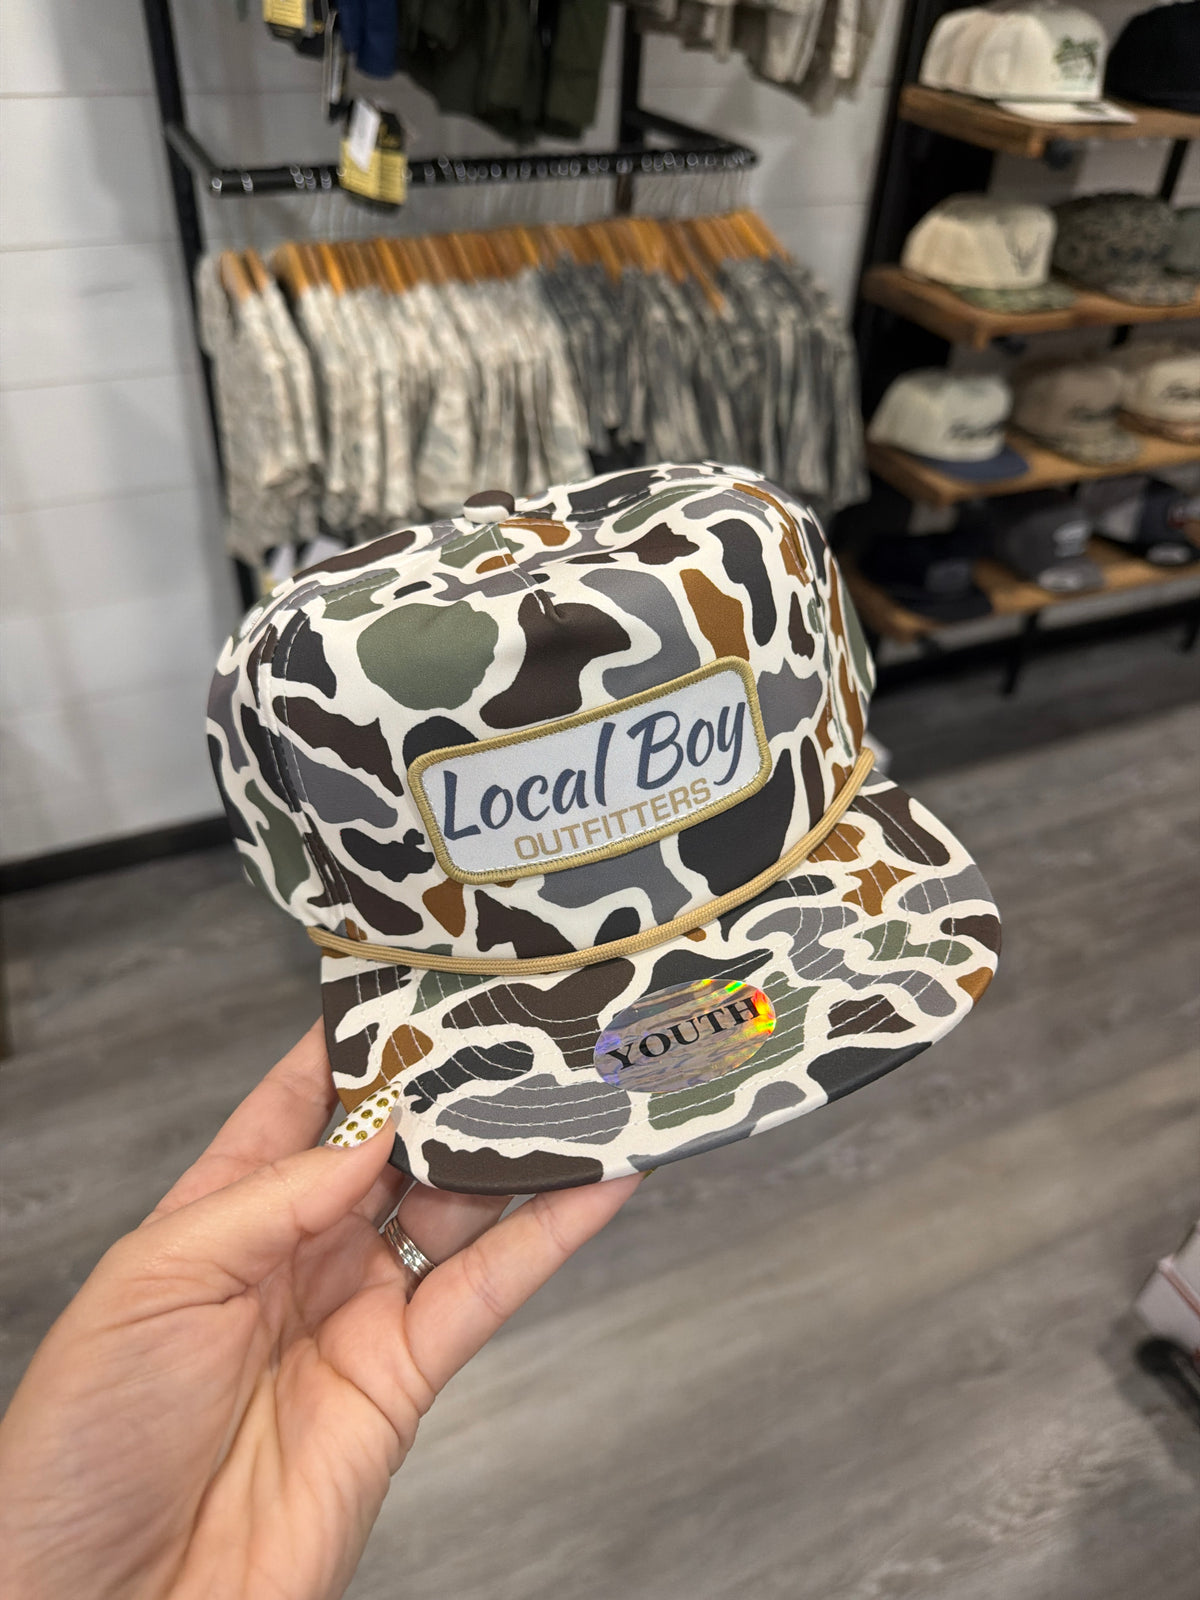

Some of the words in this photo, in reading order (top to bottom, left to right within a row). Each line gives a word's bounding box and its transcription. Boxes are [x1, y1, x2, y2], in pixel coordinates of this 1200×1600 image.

[443, 721, 616, 841] Local
[626, 701, 746, 790] Boy
[514, 777, 712, 860] OUTFITTERS
[605, 996, 760, 1070] YOUTH
